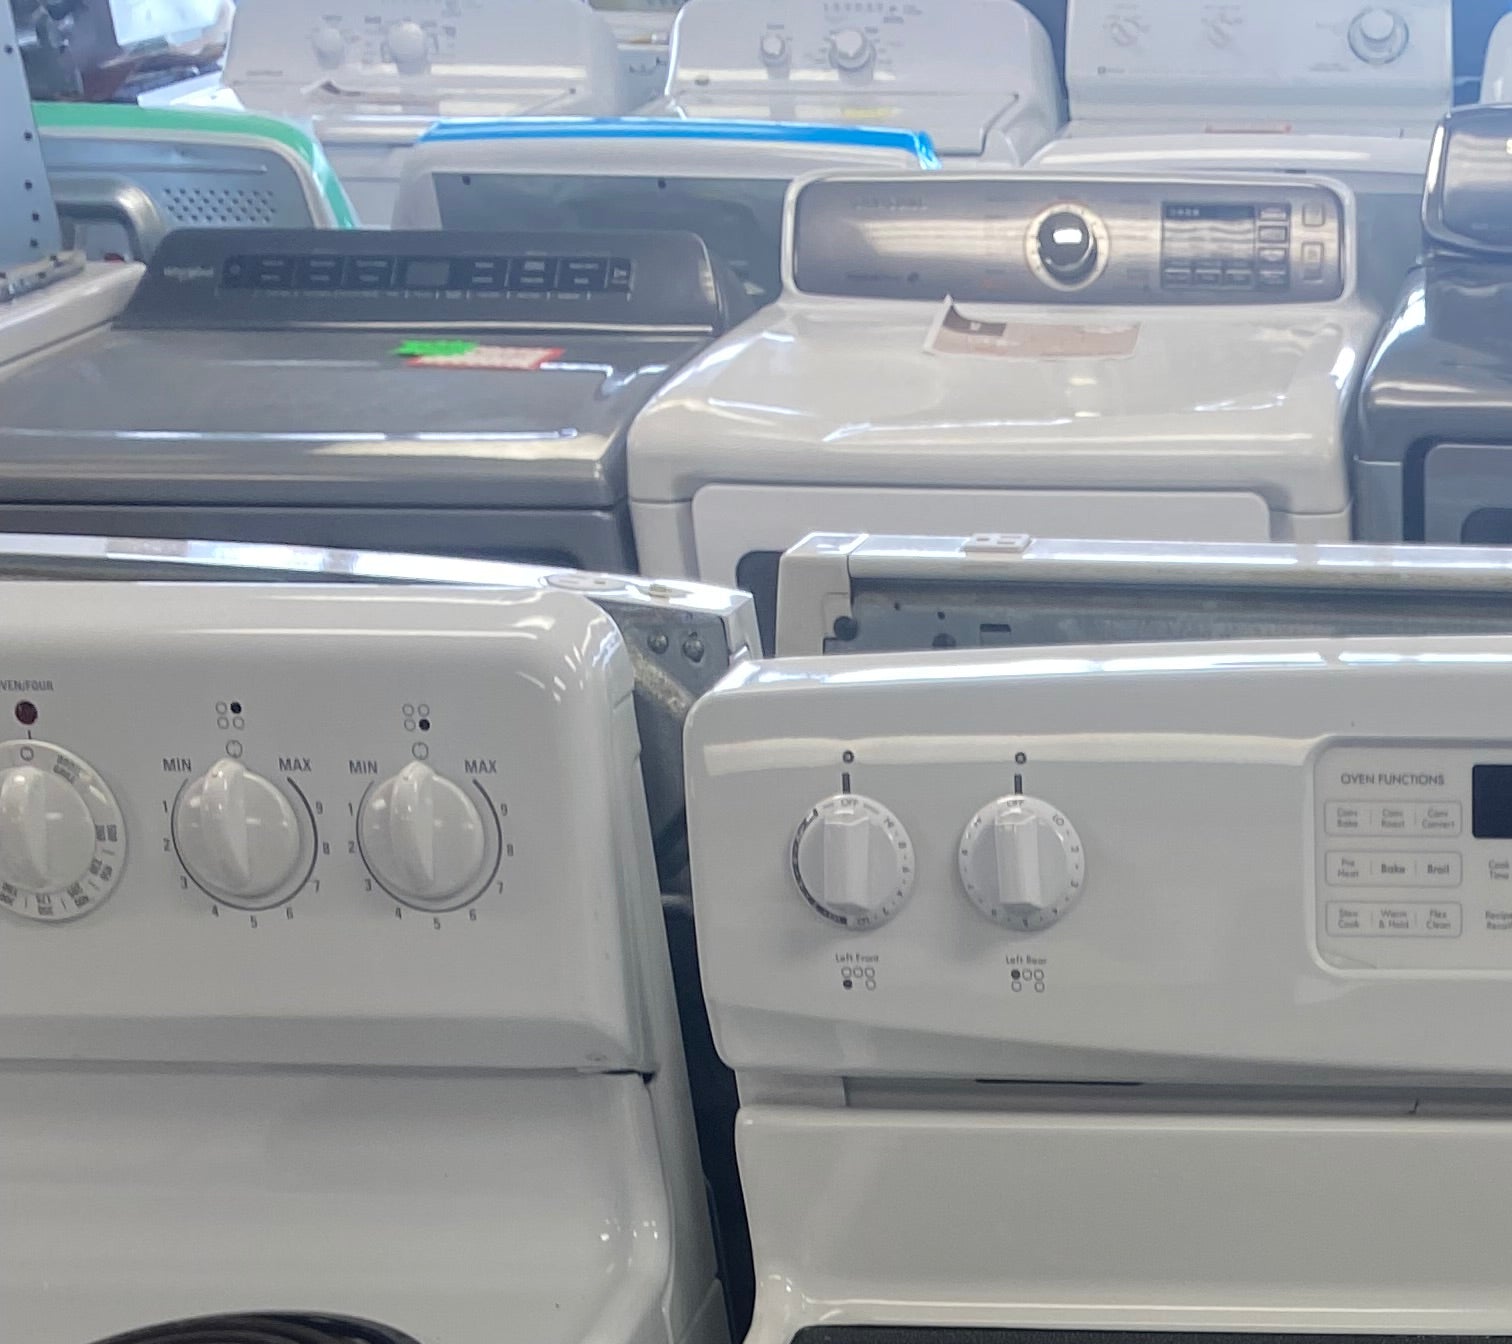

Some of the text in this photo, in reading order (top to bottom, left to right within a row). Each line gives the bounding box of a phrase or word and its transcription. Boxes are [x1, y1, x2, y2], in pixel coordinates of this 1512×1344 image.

[0, 680, 53, 691] VEN/FOUR
[163, 757, 312, 772] MIN MAX
[349, 759, 497, 774] MIN MAX
[1340, 774, 1445, 786] OVEN FUNCTIONS
[316, 802, 323, 815] 9
[163, 838, 170, 851] 2
[323, 842, 330, 855] 8
[348, 841, 355, 854] 2
[507, 844, 514, 857] 8
[1381, 864, 1406, 874] Bake
[1427, 864, 1450, 874] Broil
[181, 876, 188, 889] 3
[365, 879, 372, 891] 3
[212, 905, 219, 917] 4
[287, 907, 294, 919] 6
[469, 909, 476, 921] 6
[250, 916, 257, 928] 5
[433, 918, 441, 930] 5
